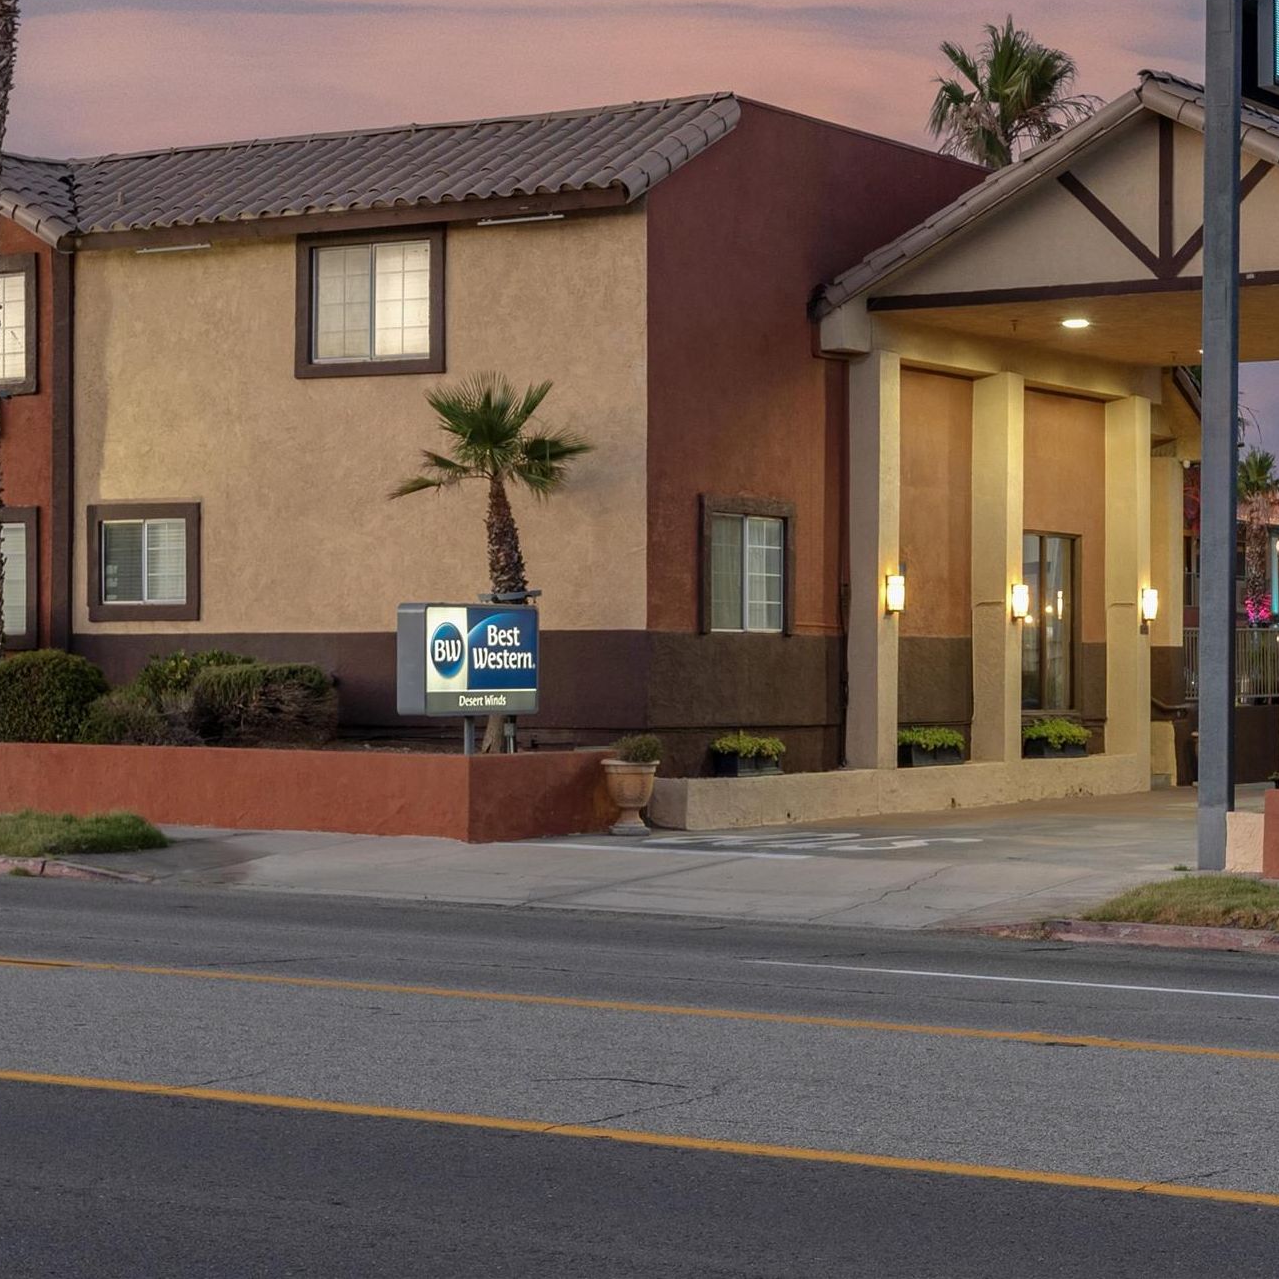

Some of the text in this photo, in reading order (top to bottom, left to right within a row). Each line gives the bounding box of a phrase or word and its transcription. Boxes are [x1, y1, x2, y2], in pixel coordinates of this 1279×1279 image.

[487, 625, 520, 646] Best
[434, 639, 461, 662] BW
[473, 647, 533, 669] Western
[459, 695, 506, 706] Desert Winds
